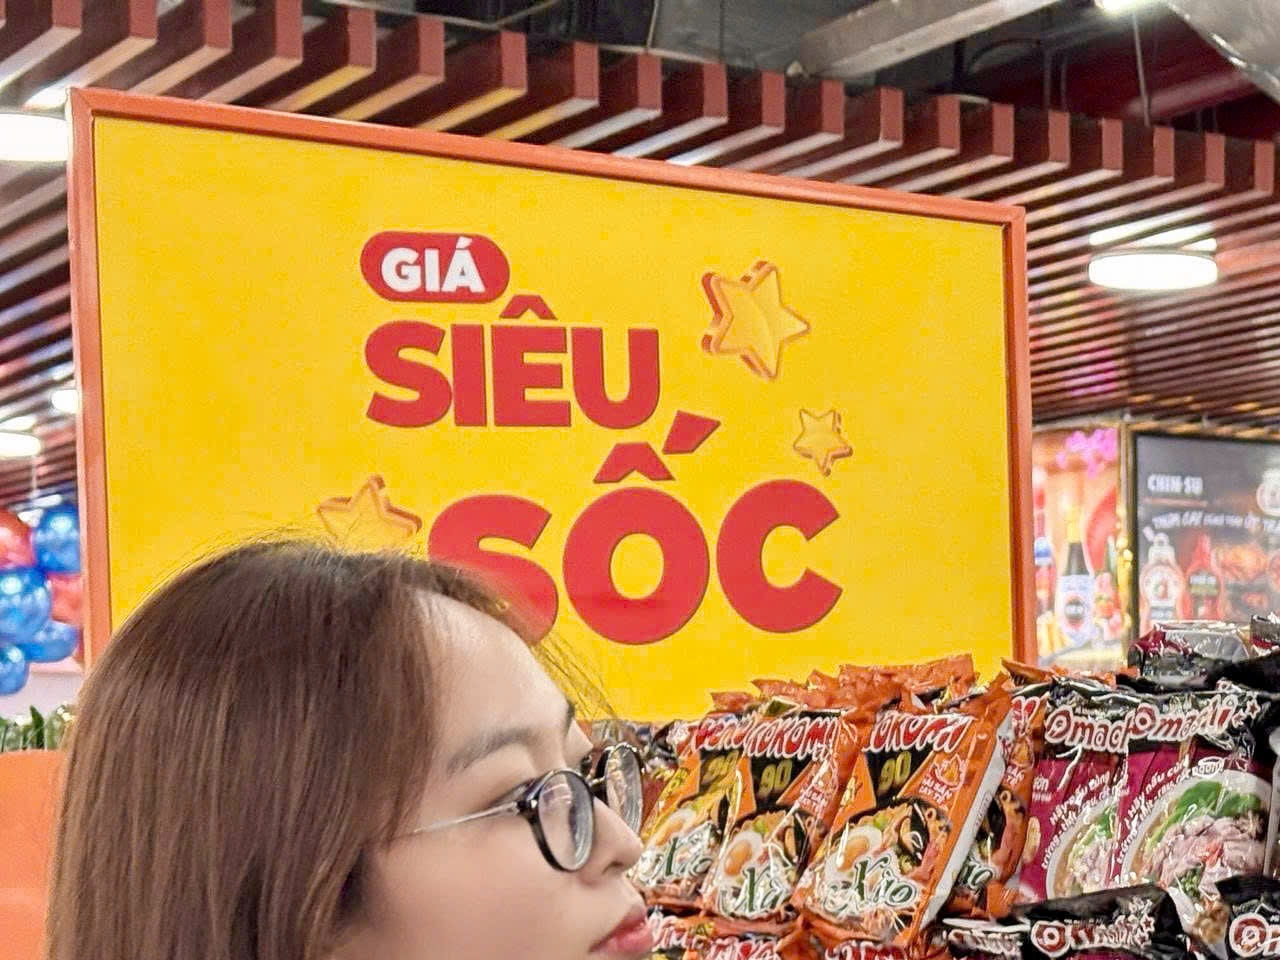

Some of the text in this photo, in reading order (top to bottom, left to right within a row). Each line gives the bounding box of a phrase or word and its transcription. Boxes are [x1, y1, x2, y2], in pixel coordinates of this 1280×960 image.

[381, 237, 485, 293] GIÁ
[364, 295, 661, 430] SIÊU
[428, 410, 844, 645] SỐC
[1045, 705, 1129, 753] Omac
[758, 757, 793, 795] 90
[879, 751, 911, 791] 90
